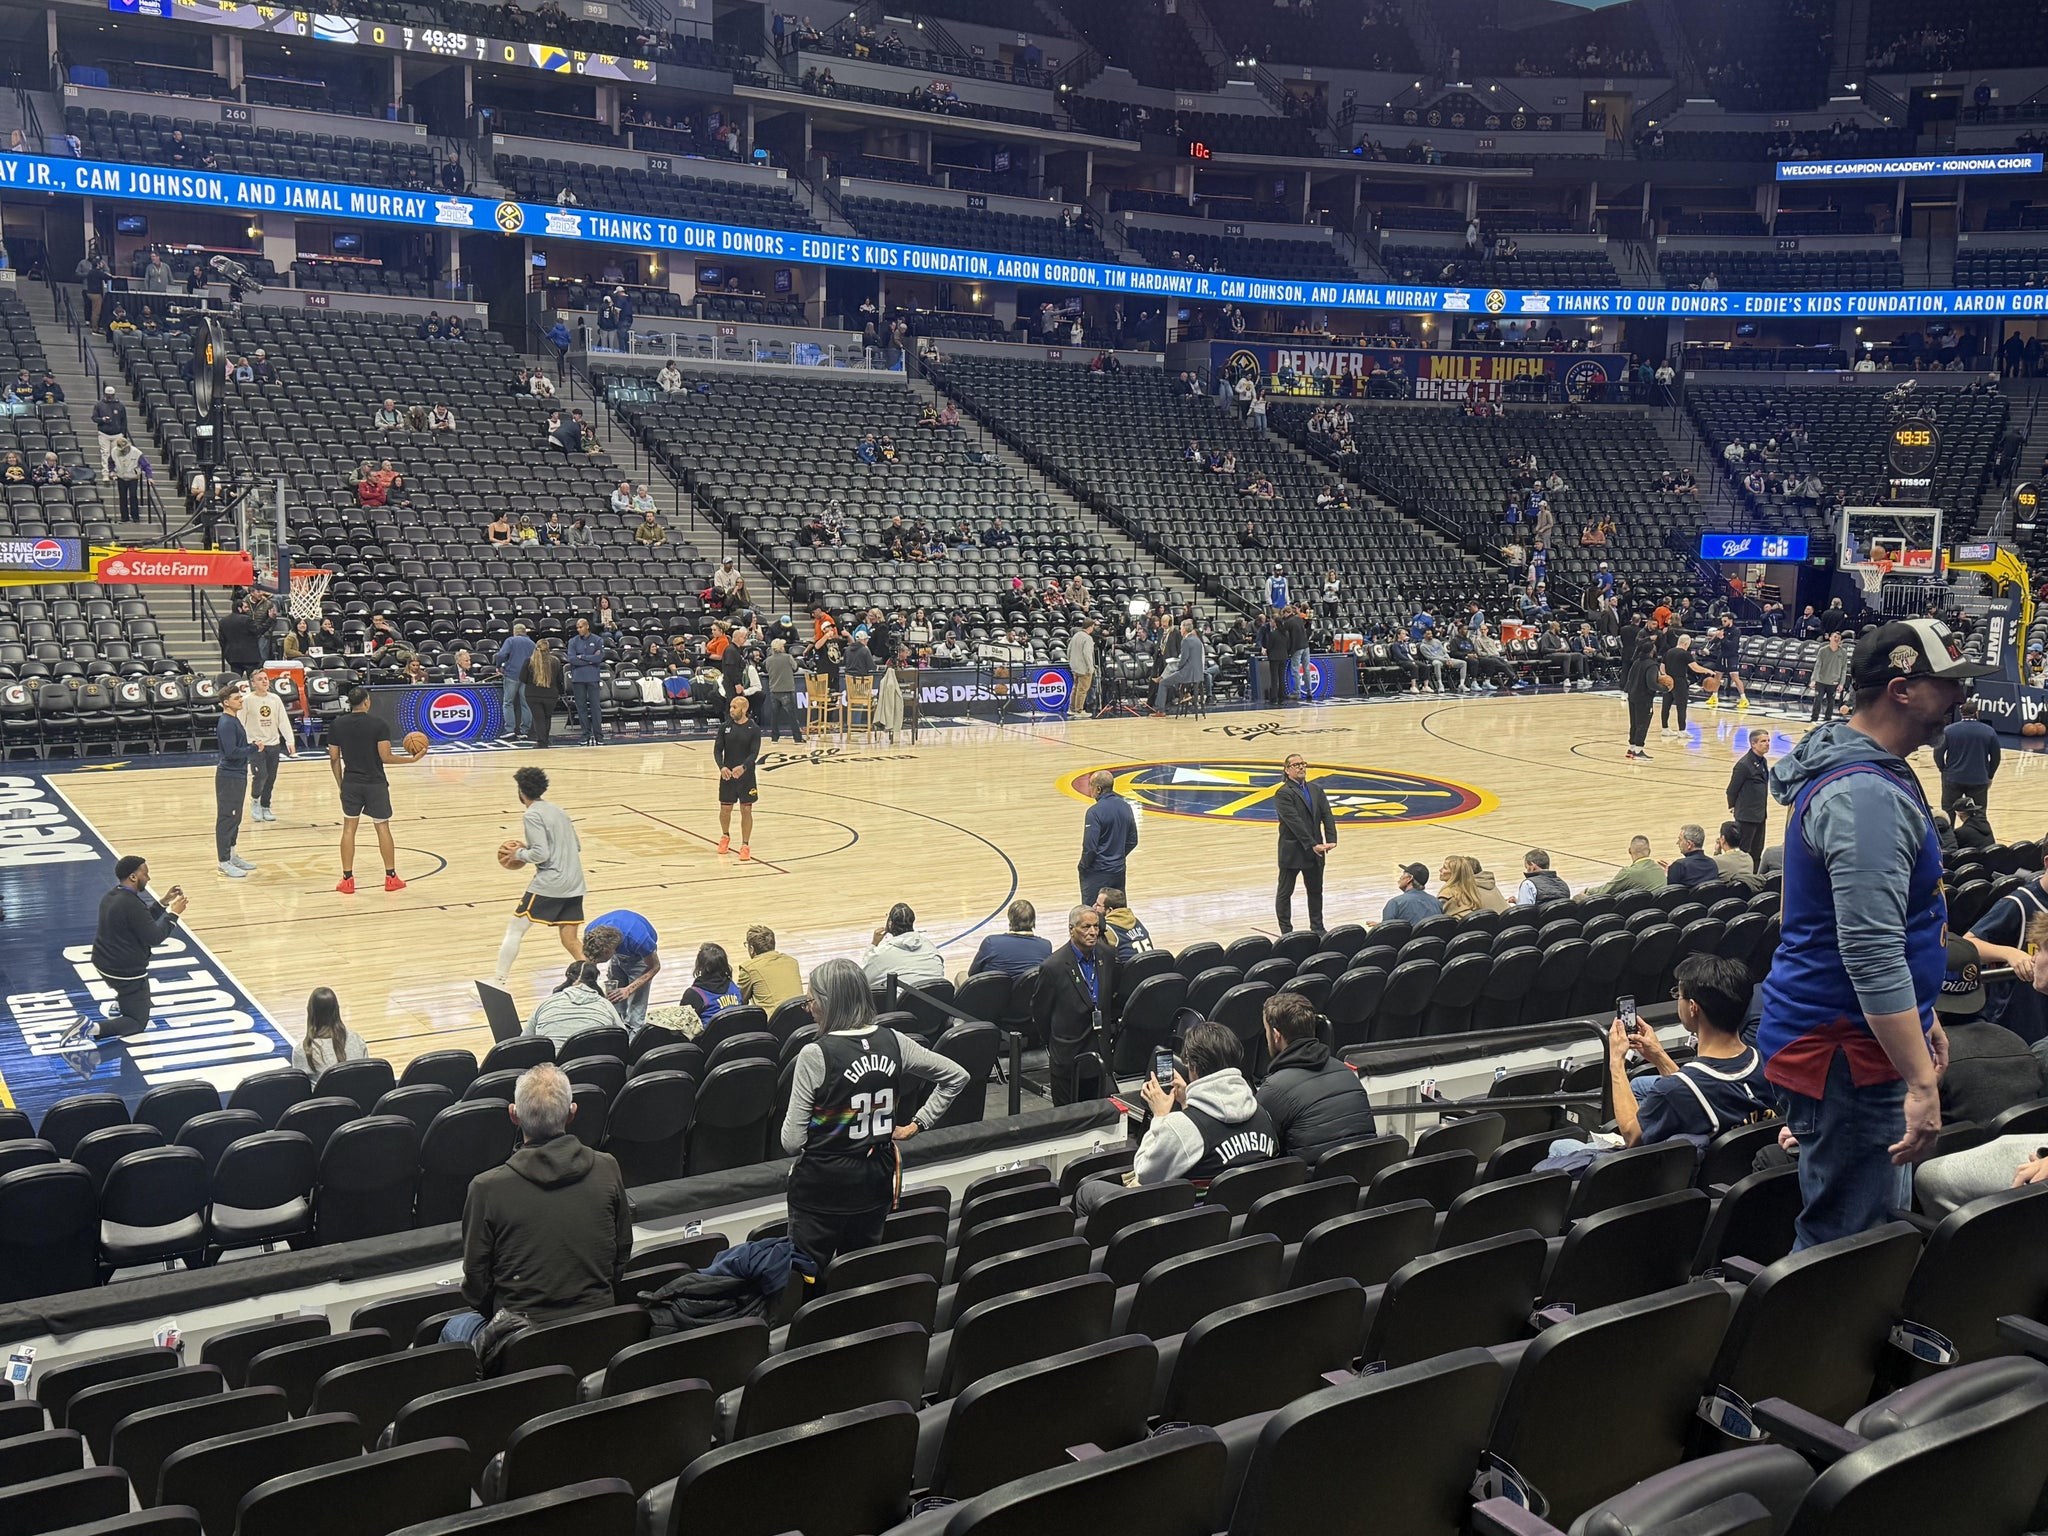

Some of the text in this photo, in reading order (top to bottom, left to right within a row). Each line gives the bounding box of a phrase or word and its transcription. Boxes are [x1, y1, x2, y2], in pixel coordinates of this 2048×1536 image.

[294, 11, 308, 22] FLS
[588, 5, 602, 14] 303
[297, 24, 306, 36] 0
[373, 28, 384, 44] 0
[404, 38, 412, 50] 7
[422, 29, 467, 49] 49:35
[477, 48, 484, 60] 7
[504, 46, 514, 62] 0
[574, 50, 586, 61] FLS
[577, 62, 584, 74] 0
[226, 109, 246, 120] 260
[652, 160, 668, 170] 202
[1782, 164, 1832, 176] WELCOME
[1834, 163, 1882, 174] CAMPION
[1884, 162, 1935, 172] ACADEMY
[1942, 160, 1996, 171] KOINONIA
[1997, 158, 2032, 169] CHOIR
[27, 163, 66, 190] JR.,
[76, 167, 120, 192] CAM
[129, 171, 229, 203] JOHNSON,
[237, 183, 275, 205] AND
[284, 186, 343, 211] JAMAL
[351, 193, 427, 218] MURRAY
[589, 217, 652, 241] THANKS
[658, 224, 677, 244] TO
[684, 227, 715, 248] OUR
[722, 231, 783, 254] DONORS
[865, 245, 898, 265] KIDS
[903, 250, 992, 277] FOUNDATION,
[998, 259, 1039, 279] AARON
[1044, 264, 1099, 288] GORDON,
[1104, 270, 1126, 287] TIM
[1130, 272, 1191, 293] HARDAWAY
[1221, 280, 1245, 298] CAM
[1248, 283, 1306, 304] JOHNSON,
[1312, 286, 1336, 303] AND
[1342, 288, 1380, 305] JAMAL
[1386, 290, 1438, 307] MURRAY
[310, 296, 326, 305] 148
[1557, 295, 1609, 310] THANKS
[1615, 296, 1632, 311] TO
[1638, 296, 1665, 311] OUR
[1672, 297, 1728, 312] DONORS
[1808, 297, 1842, 312] KIDS
[1848, 296, 1948, 314] FOUNDATION,
[1954, 295, 2005, 311] AARON
[2012, 295, 2048, 310] GOR
[1277, 350, 1363, 377] DENVER
[1431, 355, 1544, 380] MILE HIGH
[1896, 431, 1930, 446] 49:35
[9, 542, 33, 552] FANS
[1722, 538, 1752, 556] Ball
[1986, 617, 2000, 666] UMB
[1039, 685, 1065, 693] PEPSI
[1966, 693, 2016, 717] finity
[433, 709, 471, 719] PEPSI
[756, 748, 840, 766] Ball
[810, 754, 919, 765] Arena
[7, 990, 97, 1056] DENVER
[844, 1054, 896, 1084] GORDON
[849, 1088, 894, 1140] 32
[1215, 1131, 1275, 1164] JOHNSON
